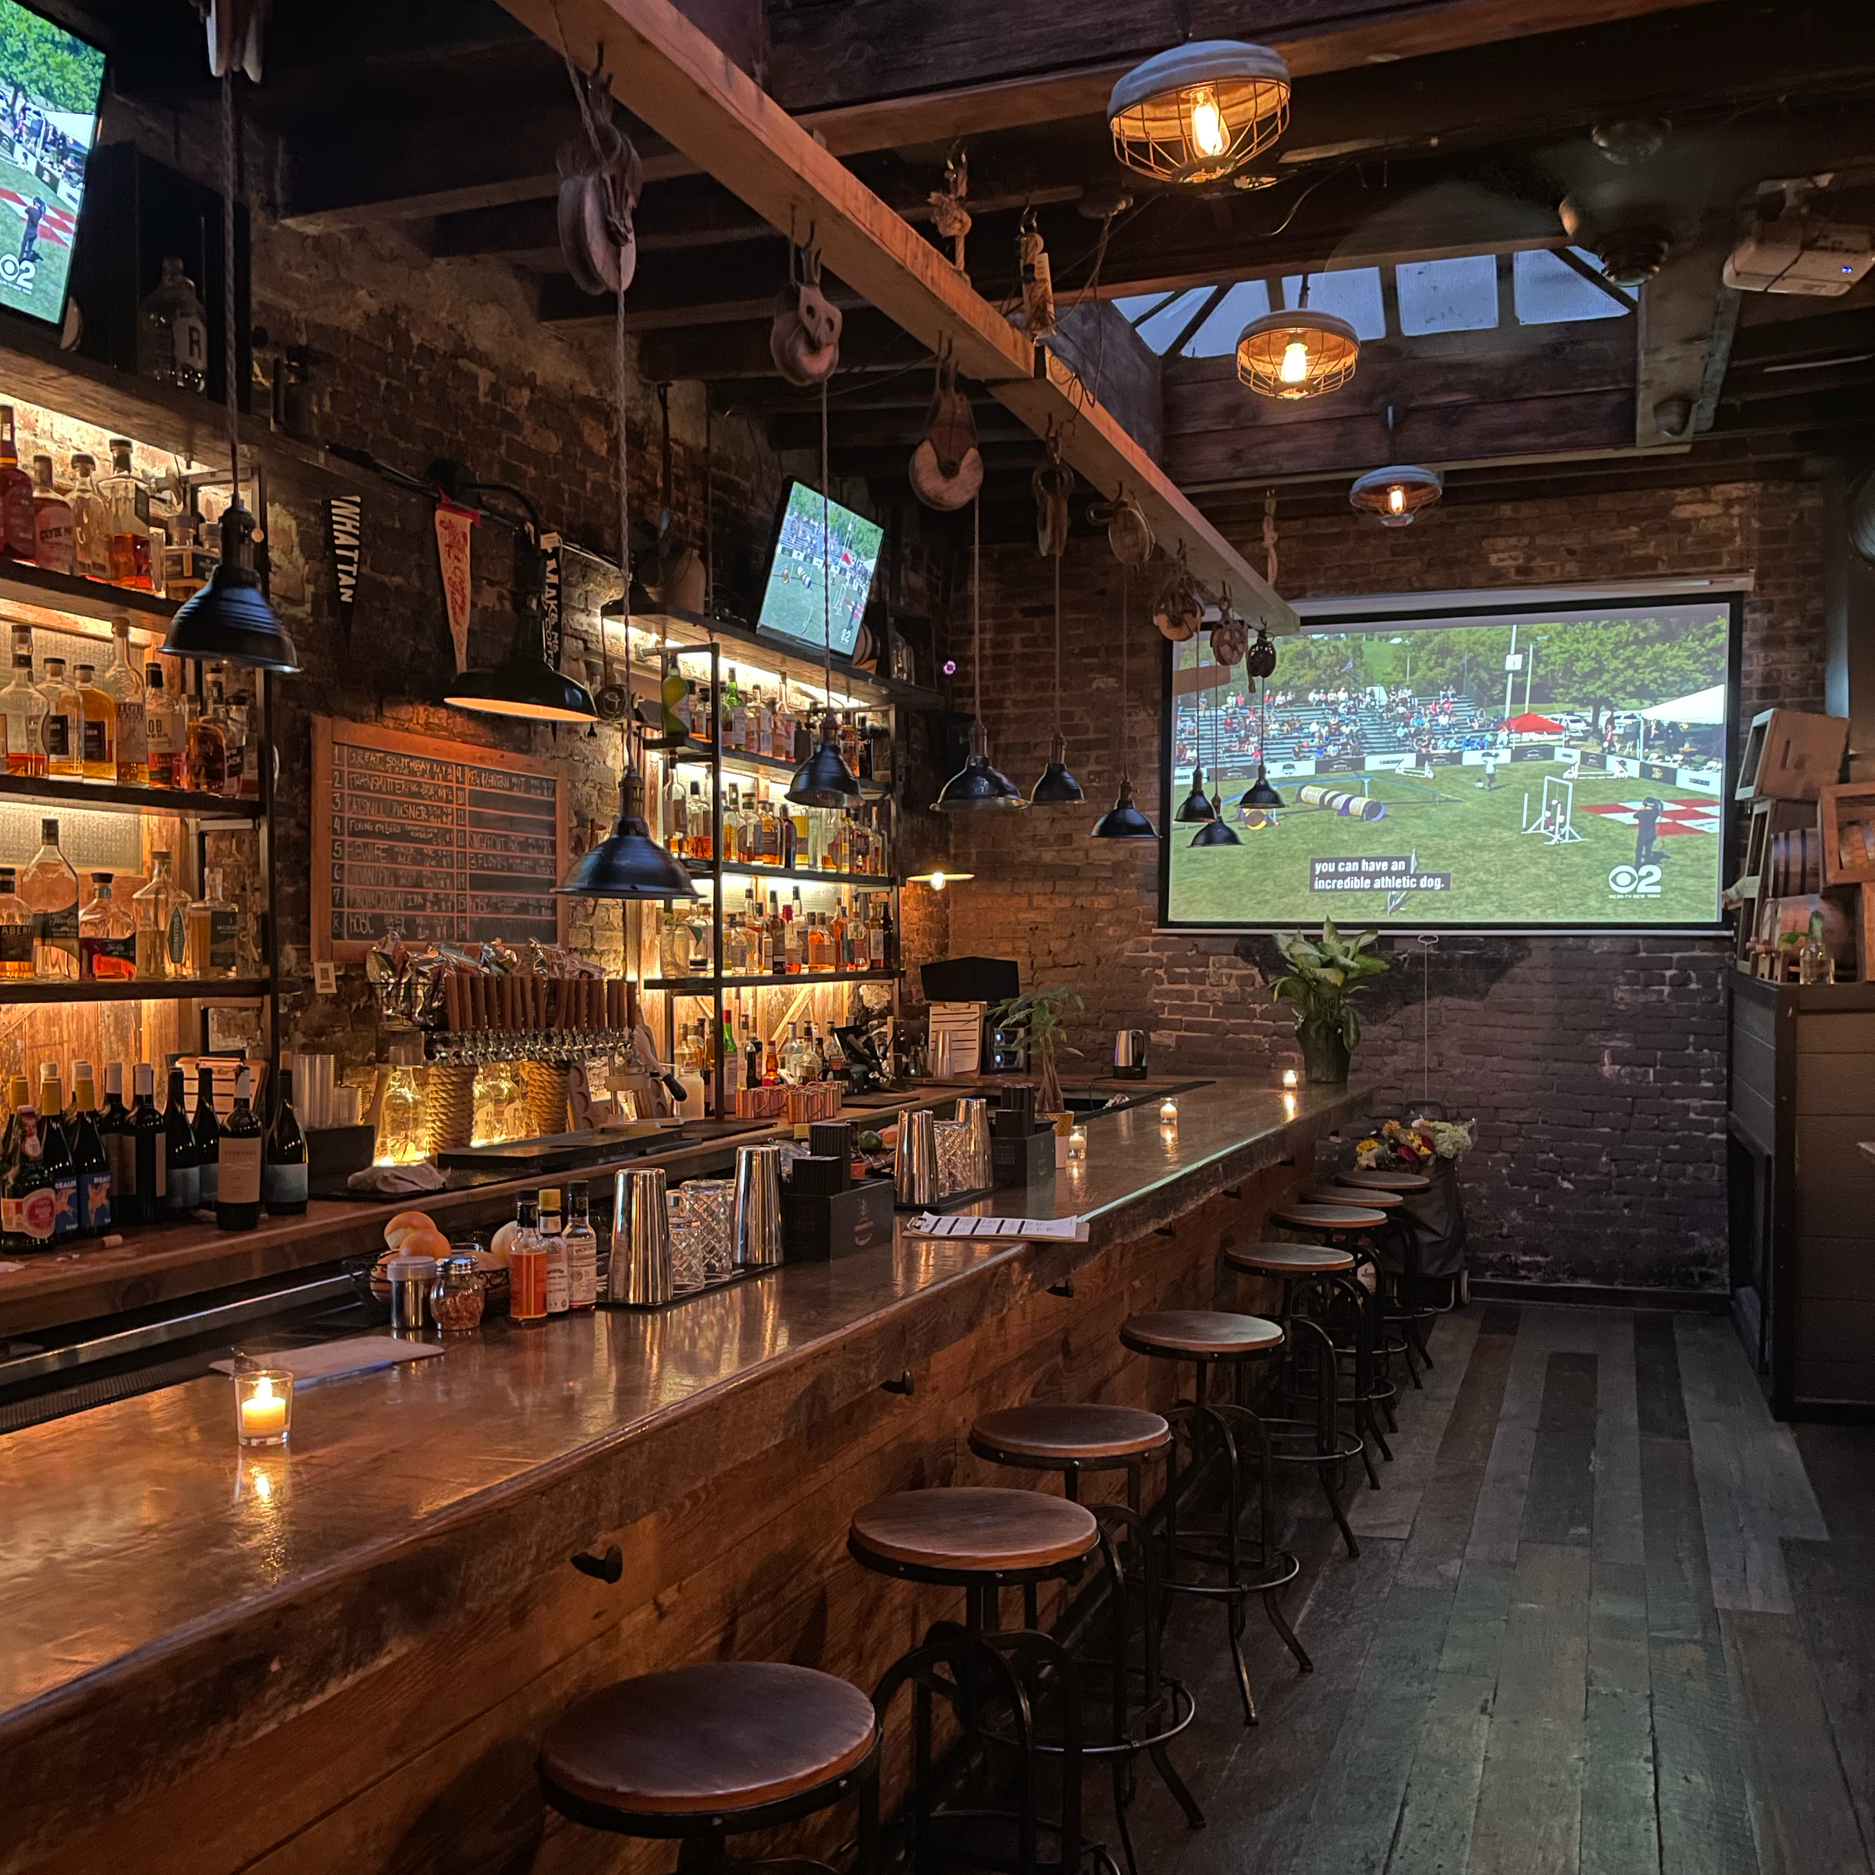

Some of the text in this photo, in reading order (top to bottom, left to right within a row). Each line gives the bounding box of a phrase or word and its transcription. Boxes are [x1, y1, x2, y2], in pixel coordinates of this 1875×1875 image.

[392, 801, 428, 820] PILSNER
[1314, 858, 1406, 875] you can have an
[1314, 875, 1445, 890] incredible athletic dog.
[1636, 864, 1662, 893] 2
[407, 894, 423, 907] IPA
